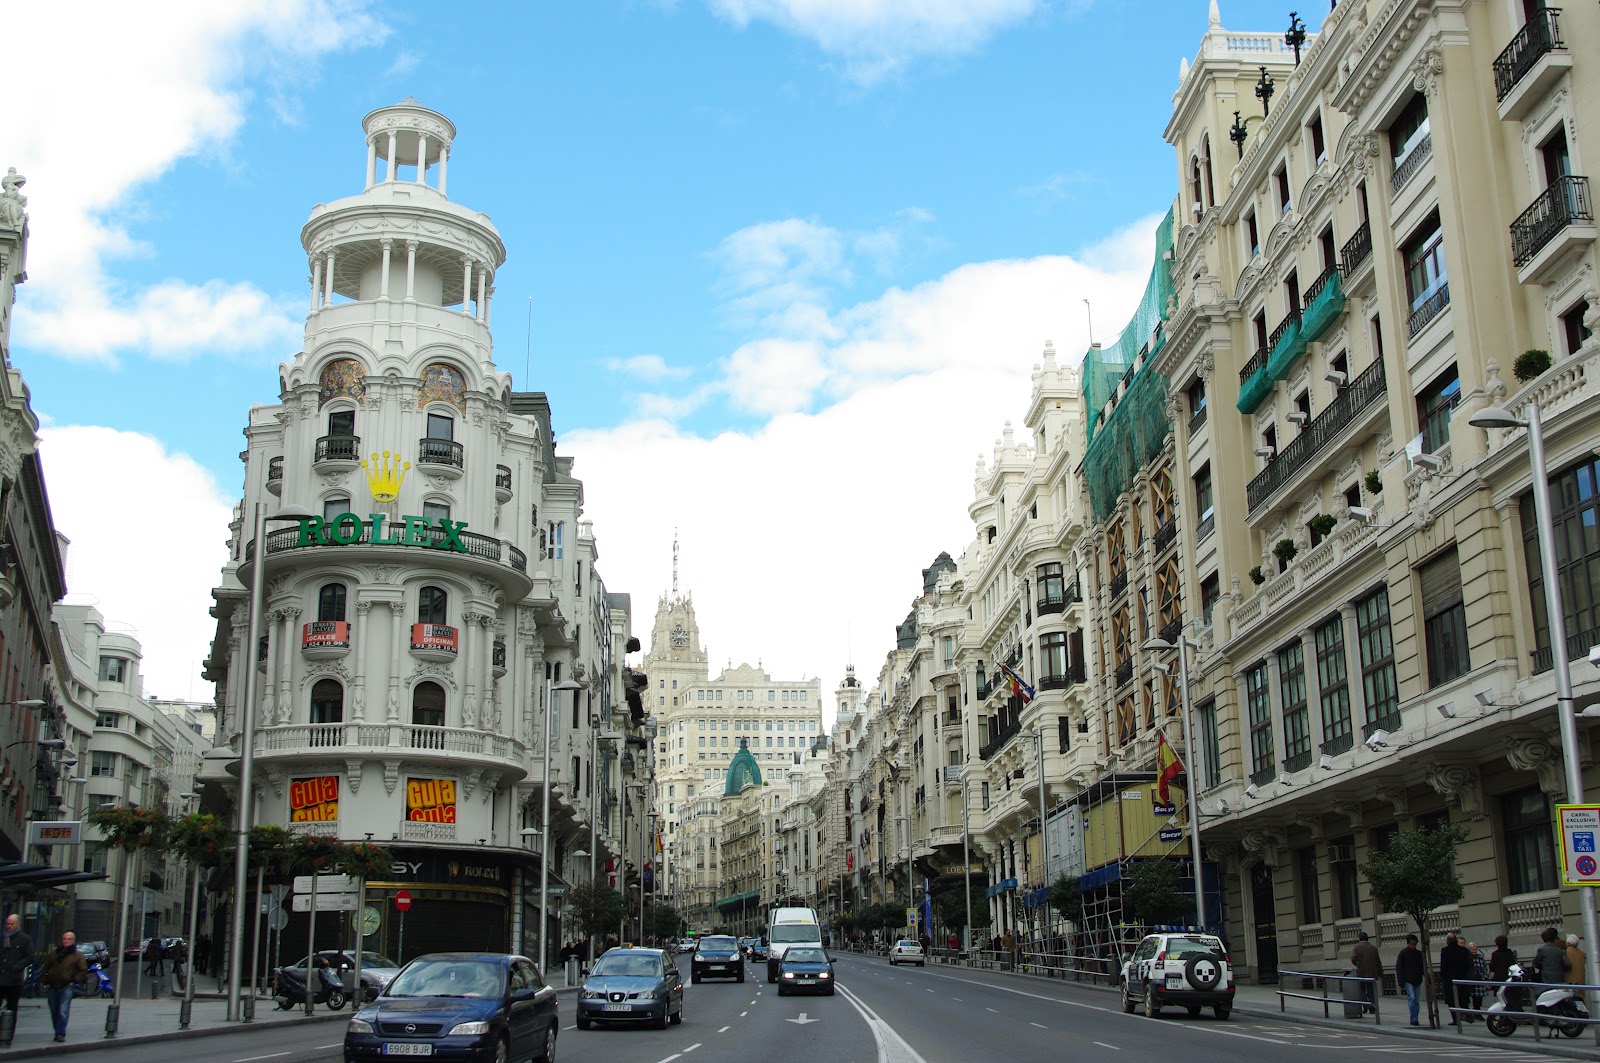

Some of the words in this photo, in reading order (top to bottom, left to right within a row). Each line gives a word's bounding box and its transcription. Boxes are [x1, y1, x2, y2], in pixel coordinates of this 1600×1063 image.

[296, 512, 469, 552] ROLEX
[306, 634, 336, 642] LOCALES
[423, 637, 454, 646] OFICINAS
[290, 776, 338, 810] Gula
[408, 779, 456, 809] Gula
[1160, 832, 1181, 840] Sacyr
[317, 861, 424, 875] GRSY
[464, 866, 495, 879] ROLEX
[389, 1044, 410, 1054] 6908
[413, 1044, 430, 1054] BJR
